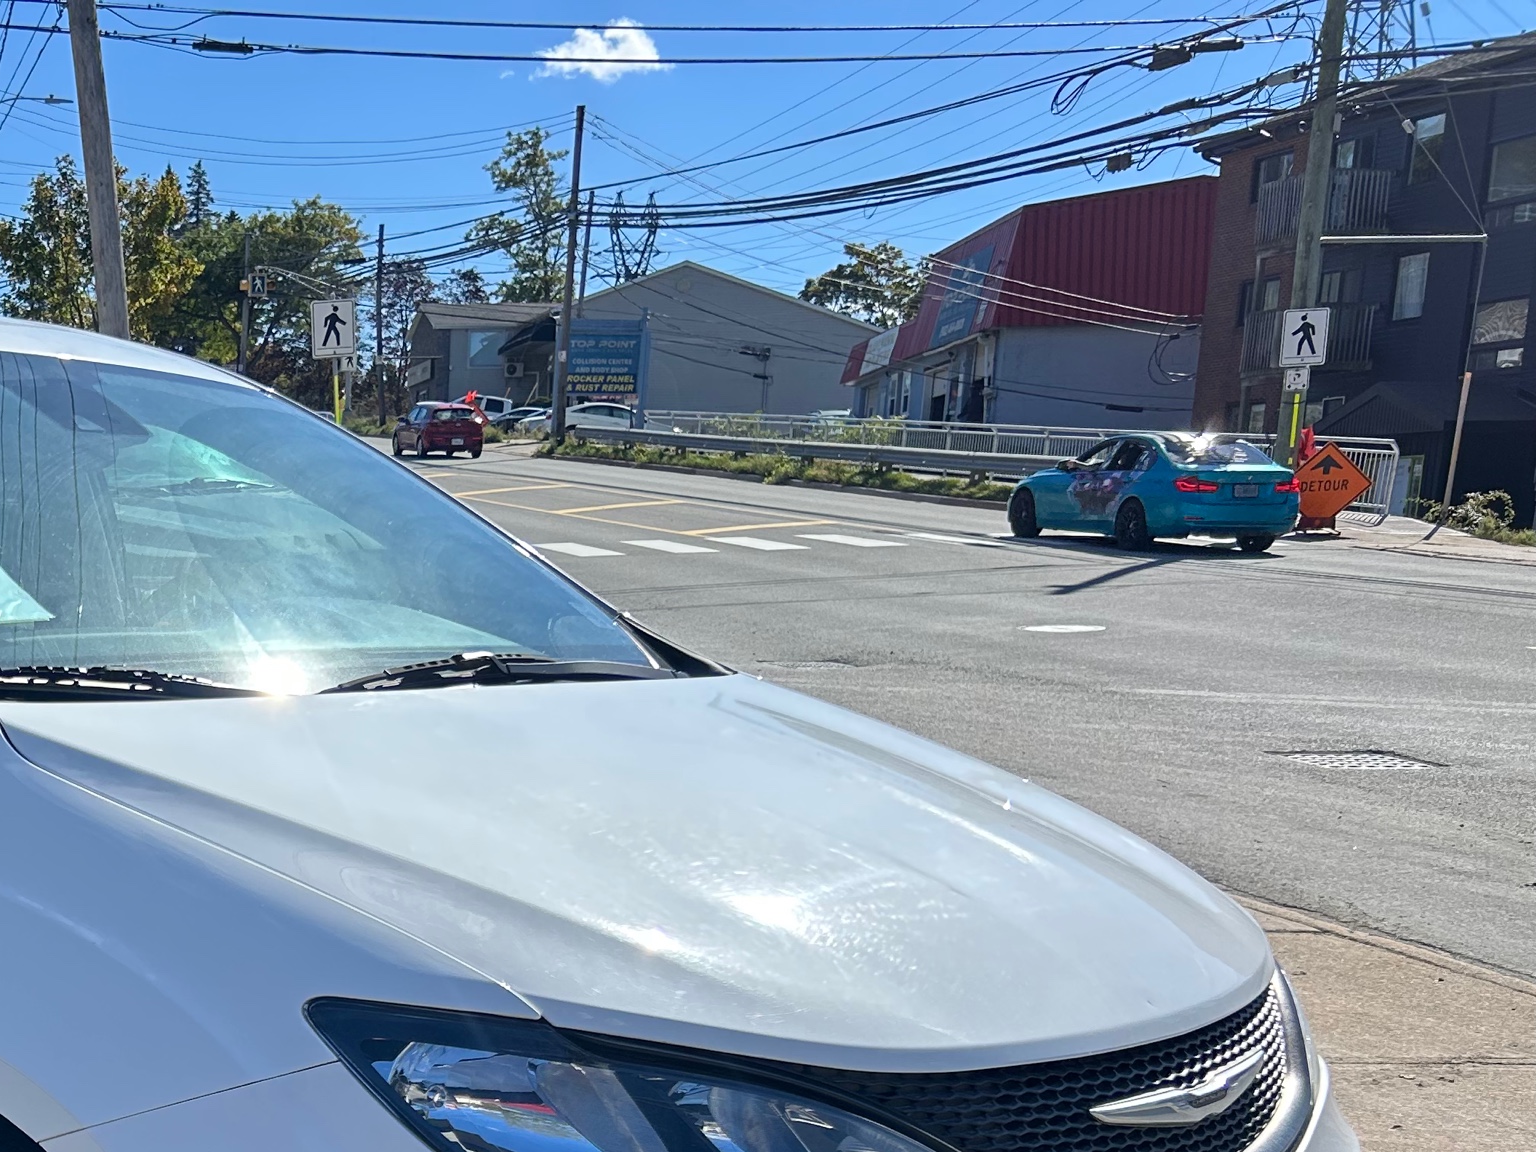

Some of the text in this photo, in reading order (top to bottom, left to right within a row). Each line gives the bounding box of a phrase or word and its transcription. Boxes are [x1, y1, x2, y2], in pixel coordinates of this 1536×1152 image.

[570, 340, 636, 348] TOP POINT
[566, 374, 605, 382] ROCKER
[1300, 479, 1348, 492] DETOUR
